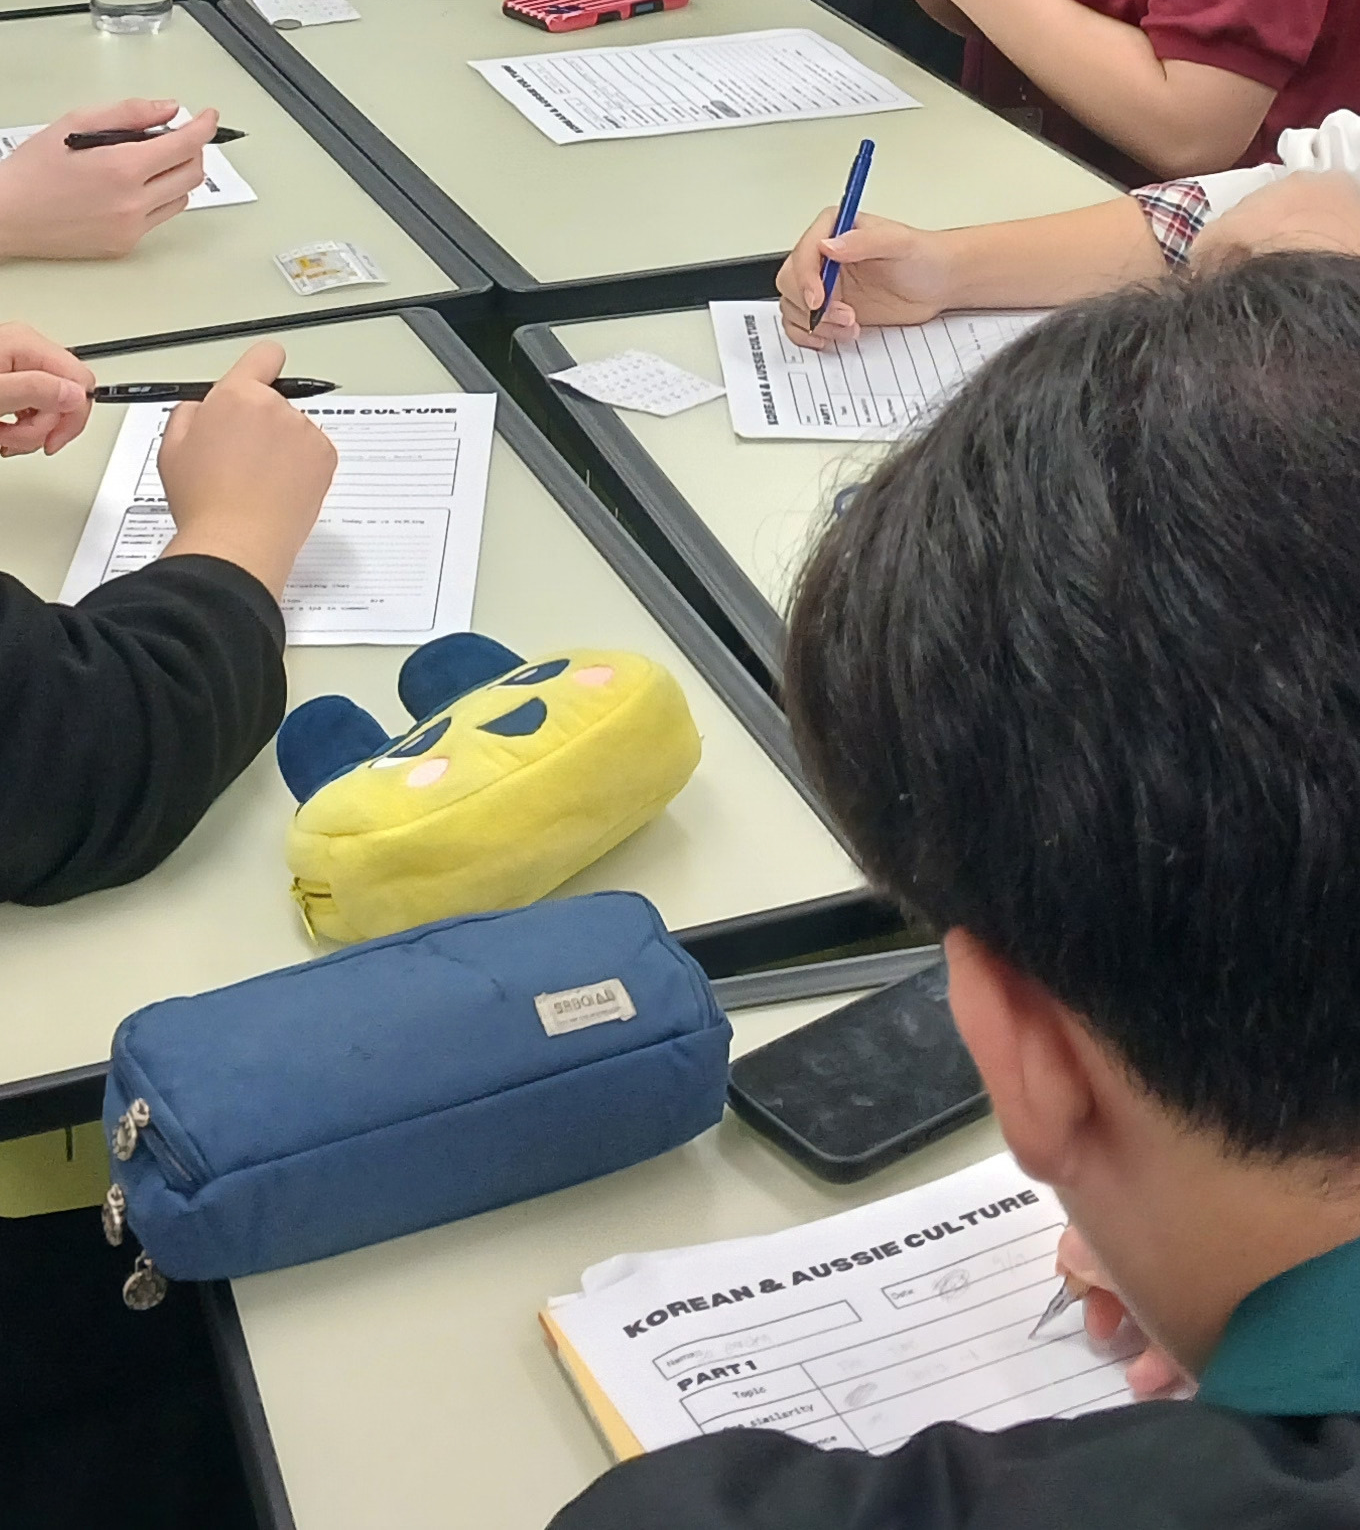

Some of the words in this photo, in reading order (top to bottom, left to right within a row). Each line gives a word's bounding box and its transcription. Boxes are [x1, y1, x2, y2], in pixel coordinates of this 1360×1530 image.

[300, 408, 355, 416] SSIE
[359, 407, 458, 415] CULTURE
[623, 1281, 756, 1339] KOREAN
[758, 1277, 787, 1294] &
[791, 1240, 903, 1286] AUSSIE
[903, 1189, 1040, 1249] CULTURE
[676, 1362, 740, 1392] PART
[745, 1359, 758, 1371] 1
[732, 1385, 767, 1400] Topic
